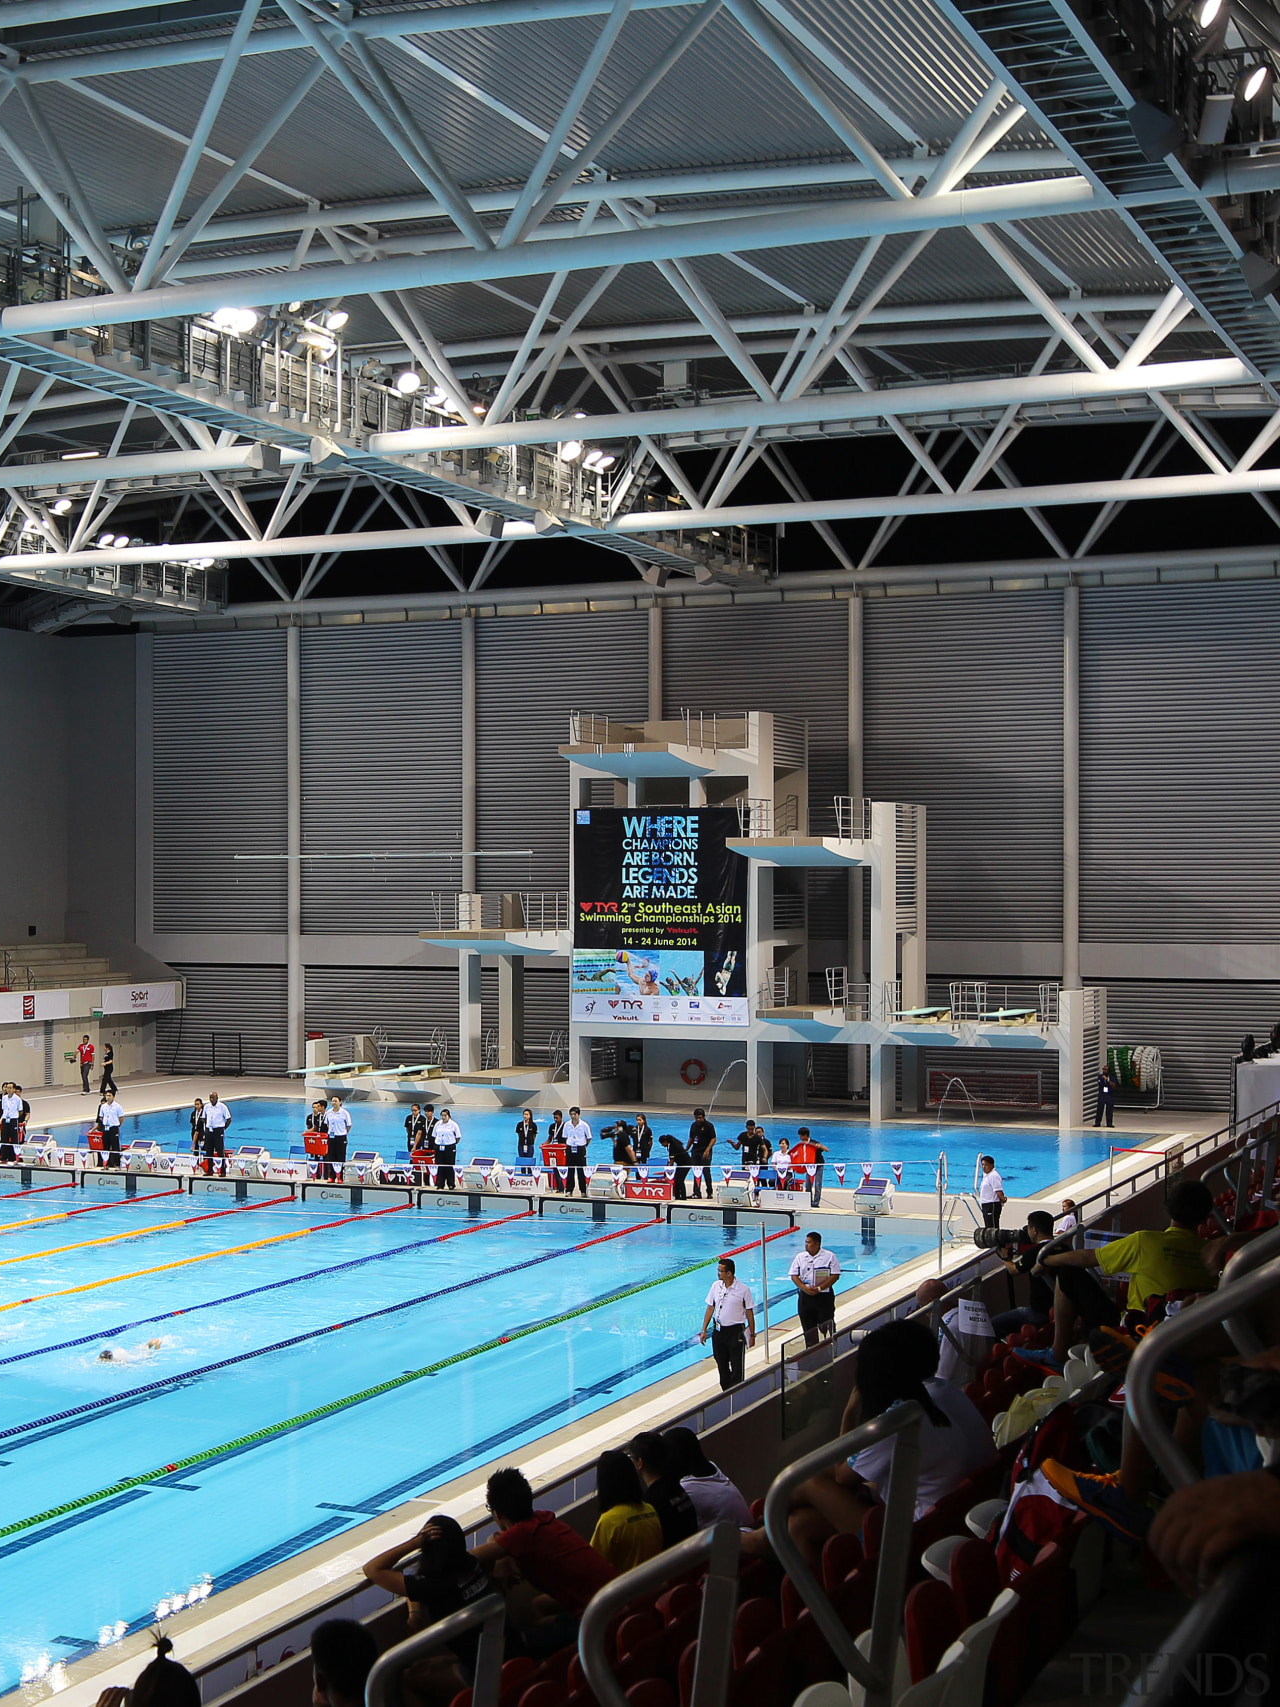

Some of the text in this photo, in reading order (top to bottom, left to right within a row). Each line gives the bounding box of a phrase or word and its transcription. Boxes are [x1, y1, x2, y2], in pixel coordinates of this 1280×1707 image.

[622, 815, 699, 838] WHERE
[622, 838, 699, 850] CHAMPIONS
[622, 851, 698, 866] ARE BORN.
[621, 867, 698, 884] LEGENDS
[622, 885, 698, 899] ARE MADE.
[594, 902, 619, 912] TYR
[639, 902, 701, 914] Southeast
[706, 902, 741, 914] Asian
[579, 912, 742, 925] Swimming Championships 2014
[621, 926, 655, 935] presented
[655, 926, 665, 935] by
[623, 937, 632, 945] 14
[641, 937, 651, 945] 24
[653, 938, 674, 946] June
[676, 938, 697, 946] 2014
[622, 1000, 643, 1010] TYR
[644, 1186, 664, 1197] TYR
